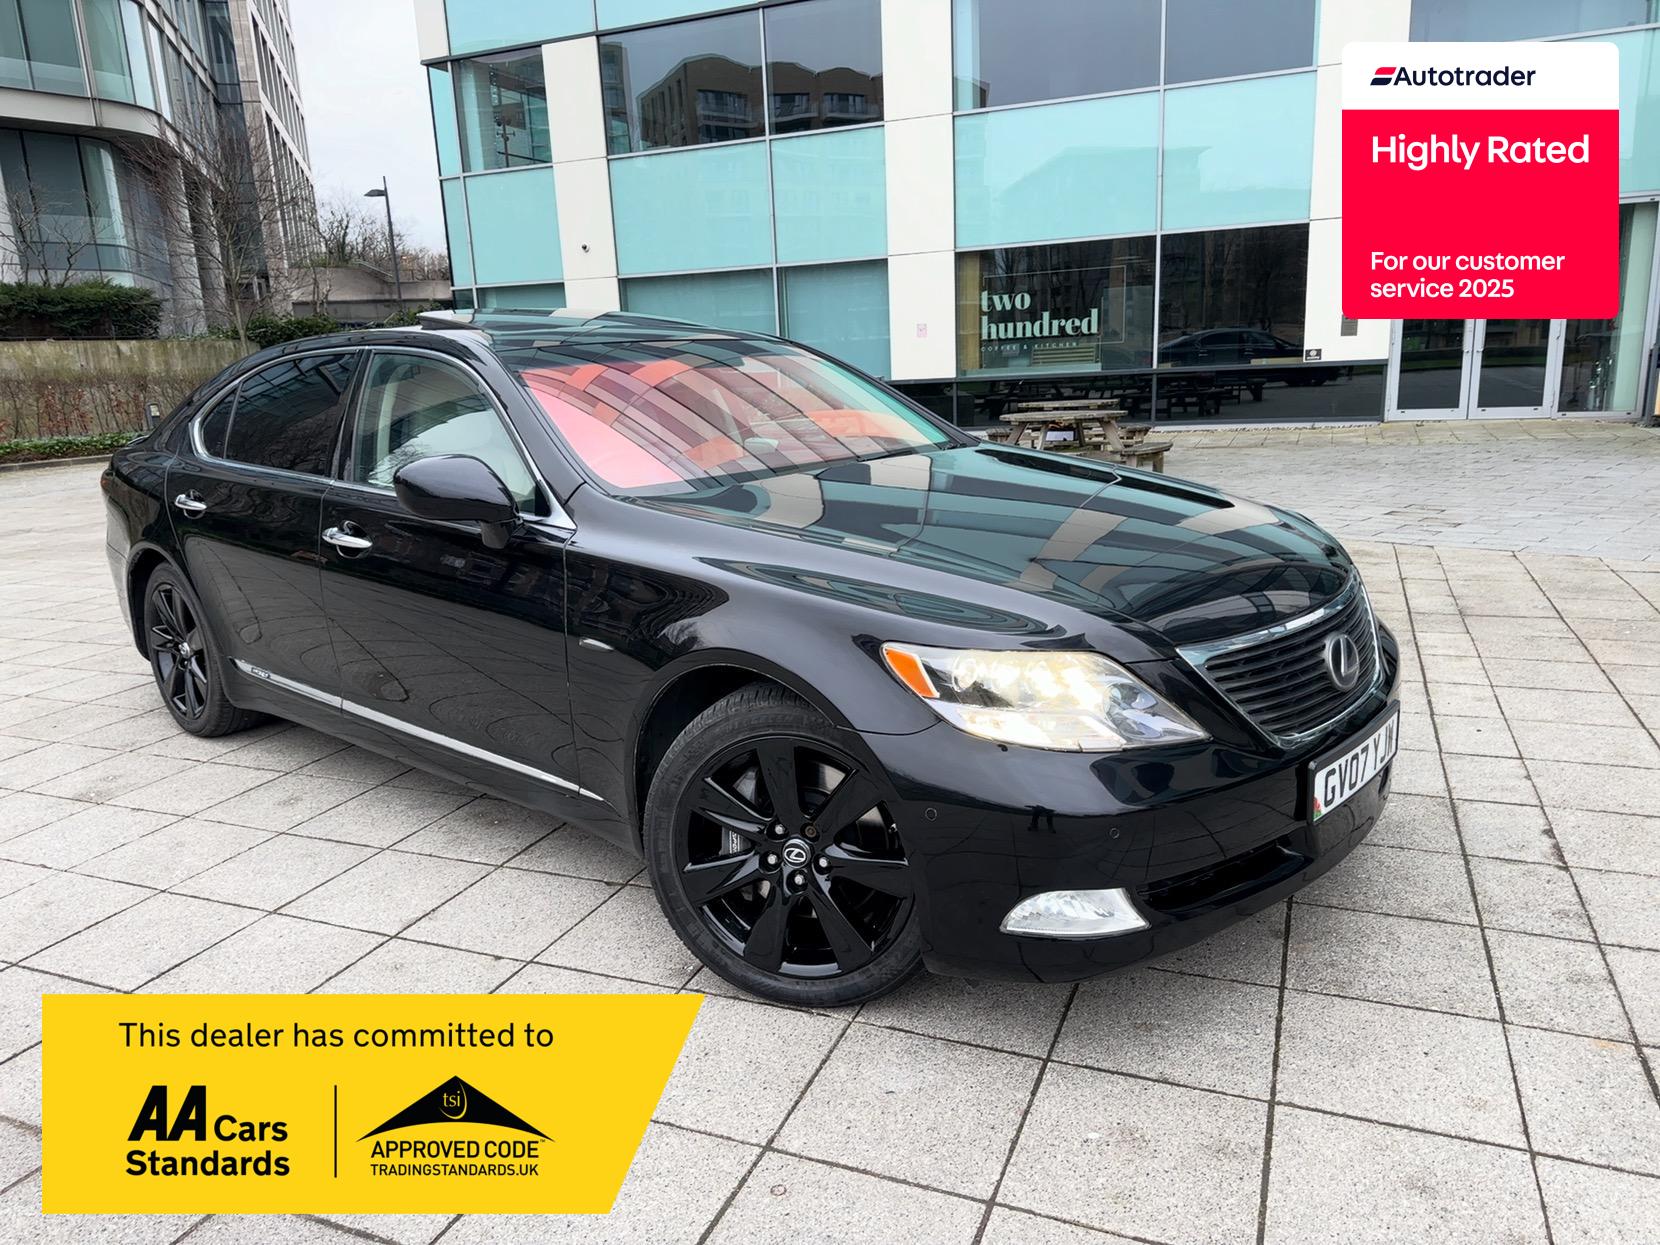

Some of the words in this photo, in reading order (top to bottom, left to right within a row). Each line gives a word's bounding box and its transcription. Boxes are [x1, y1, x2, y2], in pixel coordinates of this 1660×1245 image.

[980, 289, 1031, 313] two
[980, 308, 1100, 341] hundred
[1034, 341, 1077, 350] KITCHEN
[1323, 743, 1370, 808] GV07
